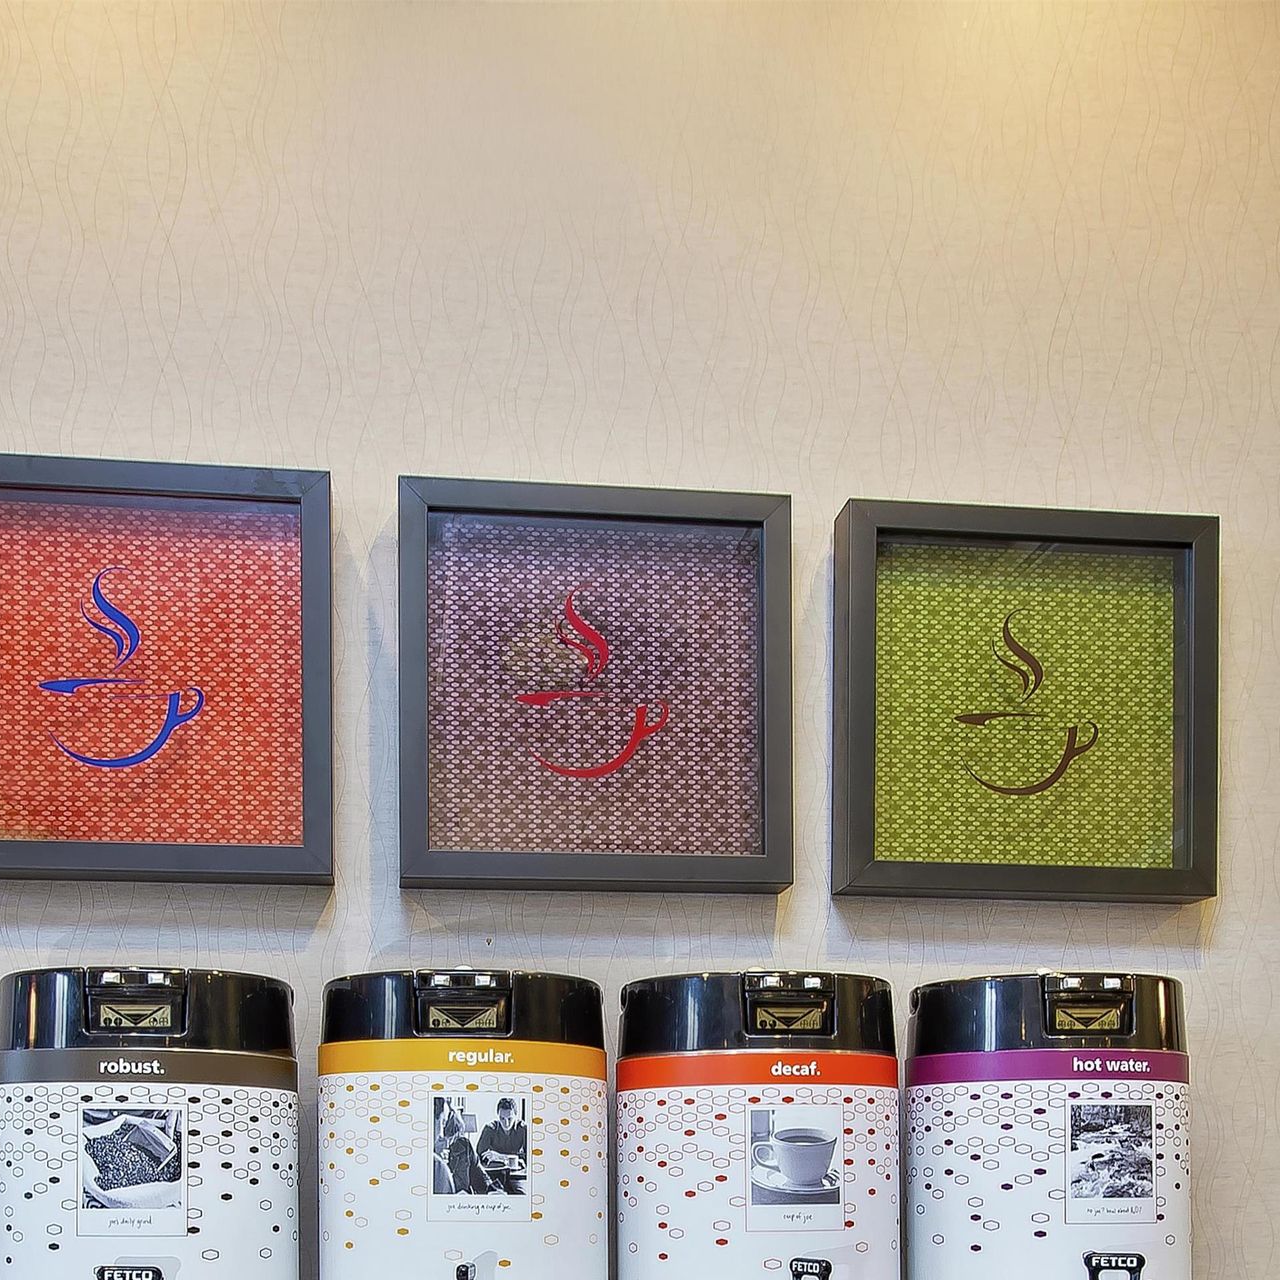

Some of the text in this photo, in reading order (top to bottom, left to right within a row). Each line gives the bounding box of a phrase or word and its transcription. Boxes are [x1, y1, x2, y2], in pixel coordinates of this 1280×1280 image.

[448, 1047, 514, 1066] regular.
[1072, 1056, 1151, 1073] hot water.
[99, 1057, 165, 1074] robust.
[770, 1060, 821, 1076] decaf.
[792, 1261, 820, 1273] FETCO
[1091, 1256, 1137, 1267] FETCO
[104, 1270, 153, 1280] FETCO
